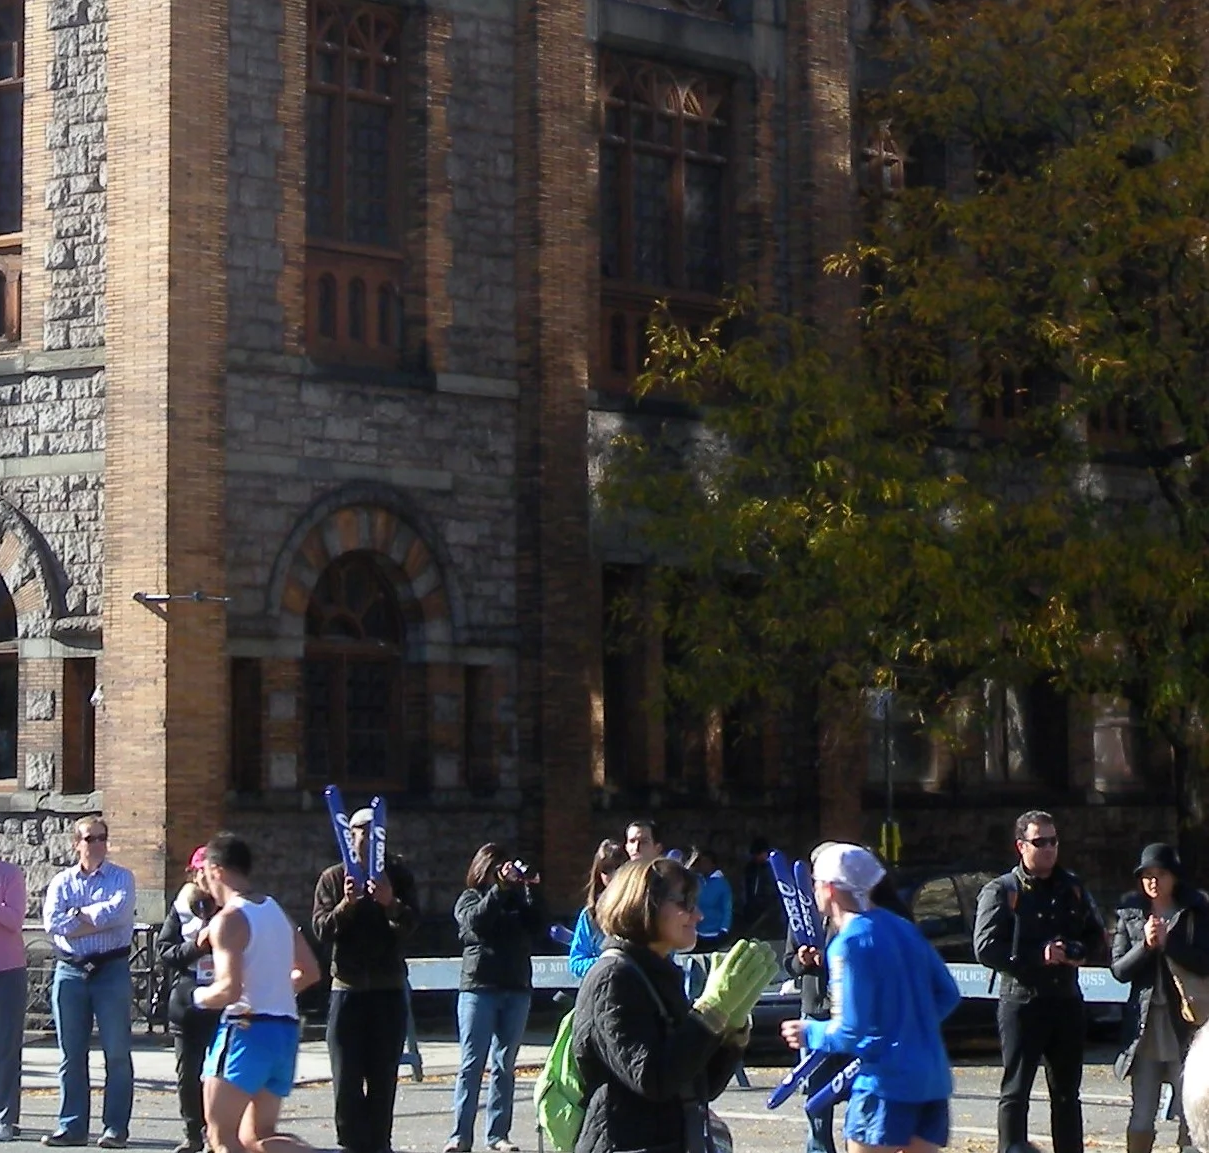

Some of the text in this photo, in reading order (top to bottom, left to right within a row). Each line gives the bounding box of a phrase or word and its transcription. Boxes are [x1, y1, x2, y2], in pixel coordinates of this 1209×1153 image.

[783, 896, 805, 932] asics
[533, 962, 546, 973] DO
[1081, 972, 1106, 986] OSS
